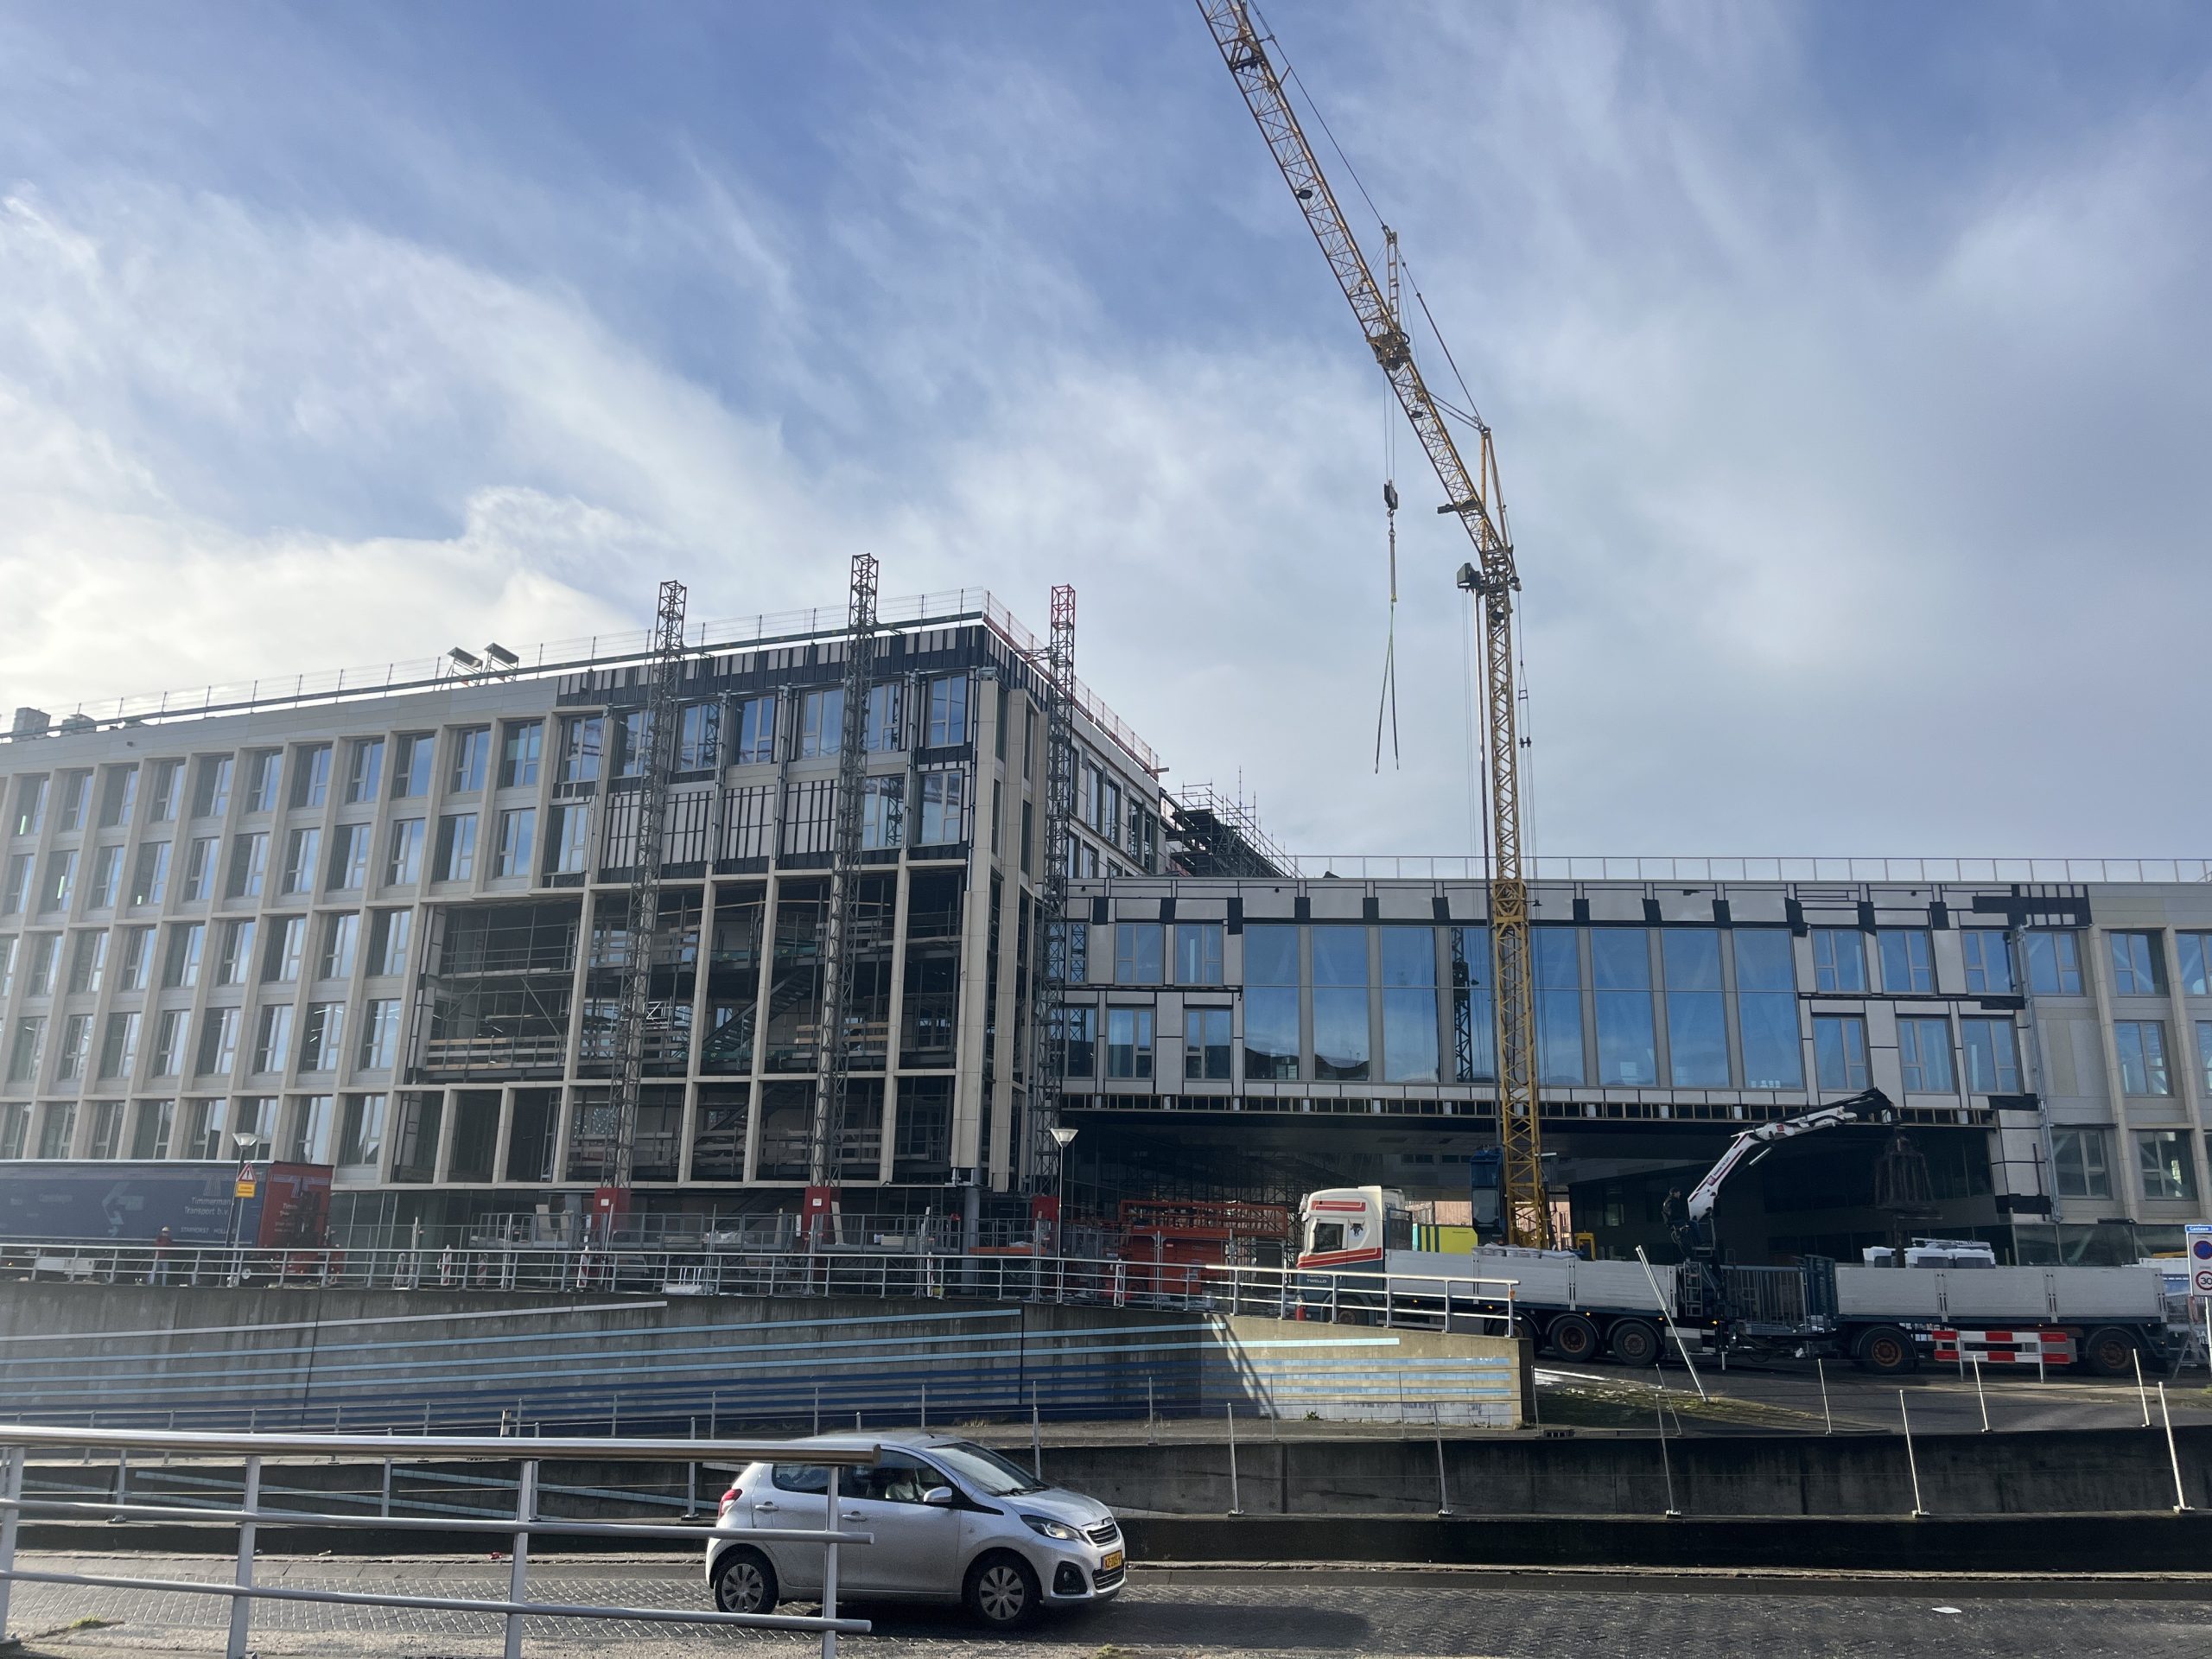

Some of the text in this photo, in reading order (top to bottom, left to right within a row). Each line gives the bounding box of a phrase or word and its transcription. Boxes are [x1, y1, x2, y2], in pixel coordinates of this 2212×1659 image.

[191, 1197, 232, 1205] Timmerman
[184, 1206, 215, 1216] Transport
[2200, 1277, 2212, 1286] 30
